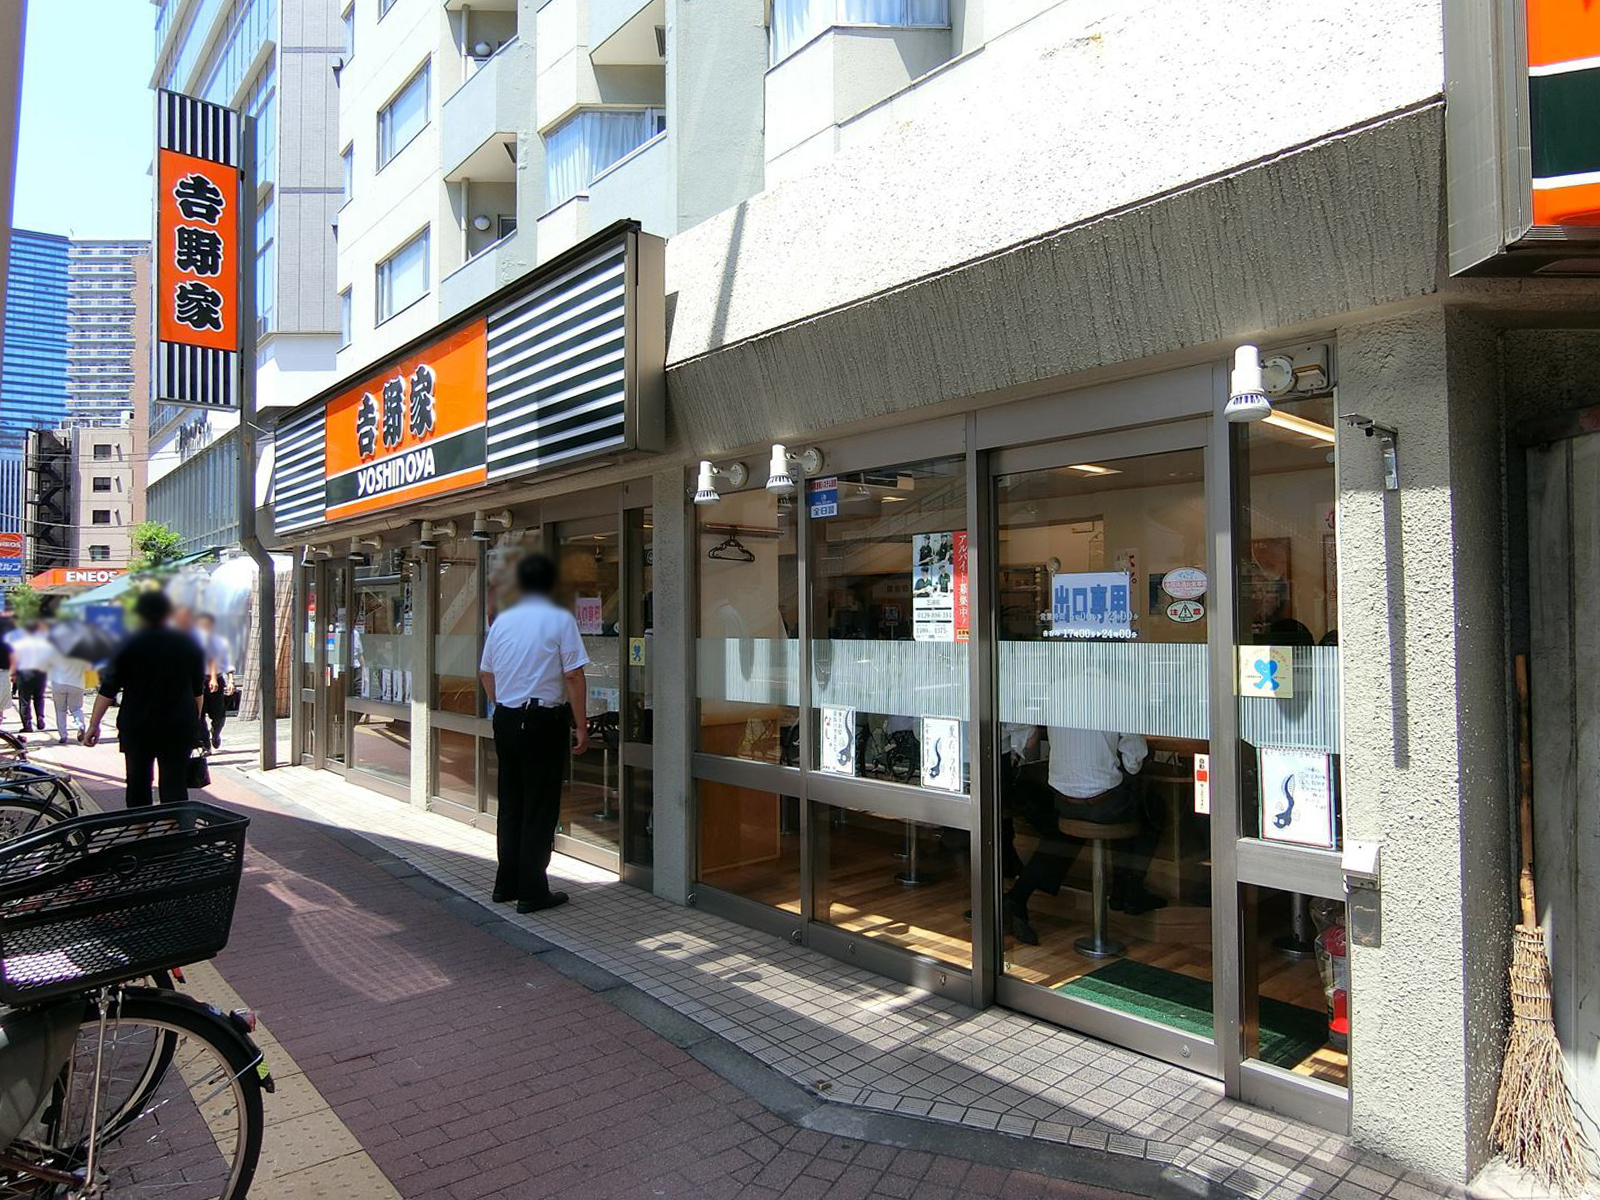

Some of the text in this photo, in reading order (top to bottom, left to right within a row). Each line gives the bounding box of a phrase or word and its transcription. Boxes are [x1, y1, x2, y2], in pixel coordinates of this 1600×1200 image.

[357, 364, 435, 459] 吉野家
[357, 447, 436, 497] YOSHINOYA
[65, 571, 117, 583] ENEOS
[1054, 584, 1128, 623] 出口専用
